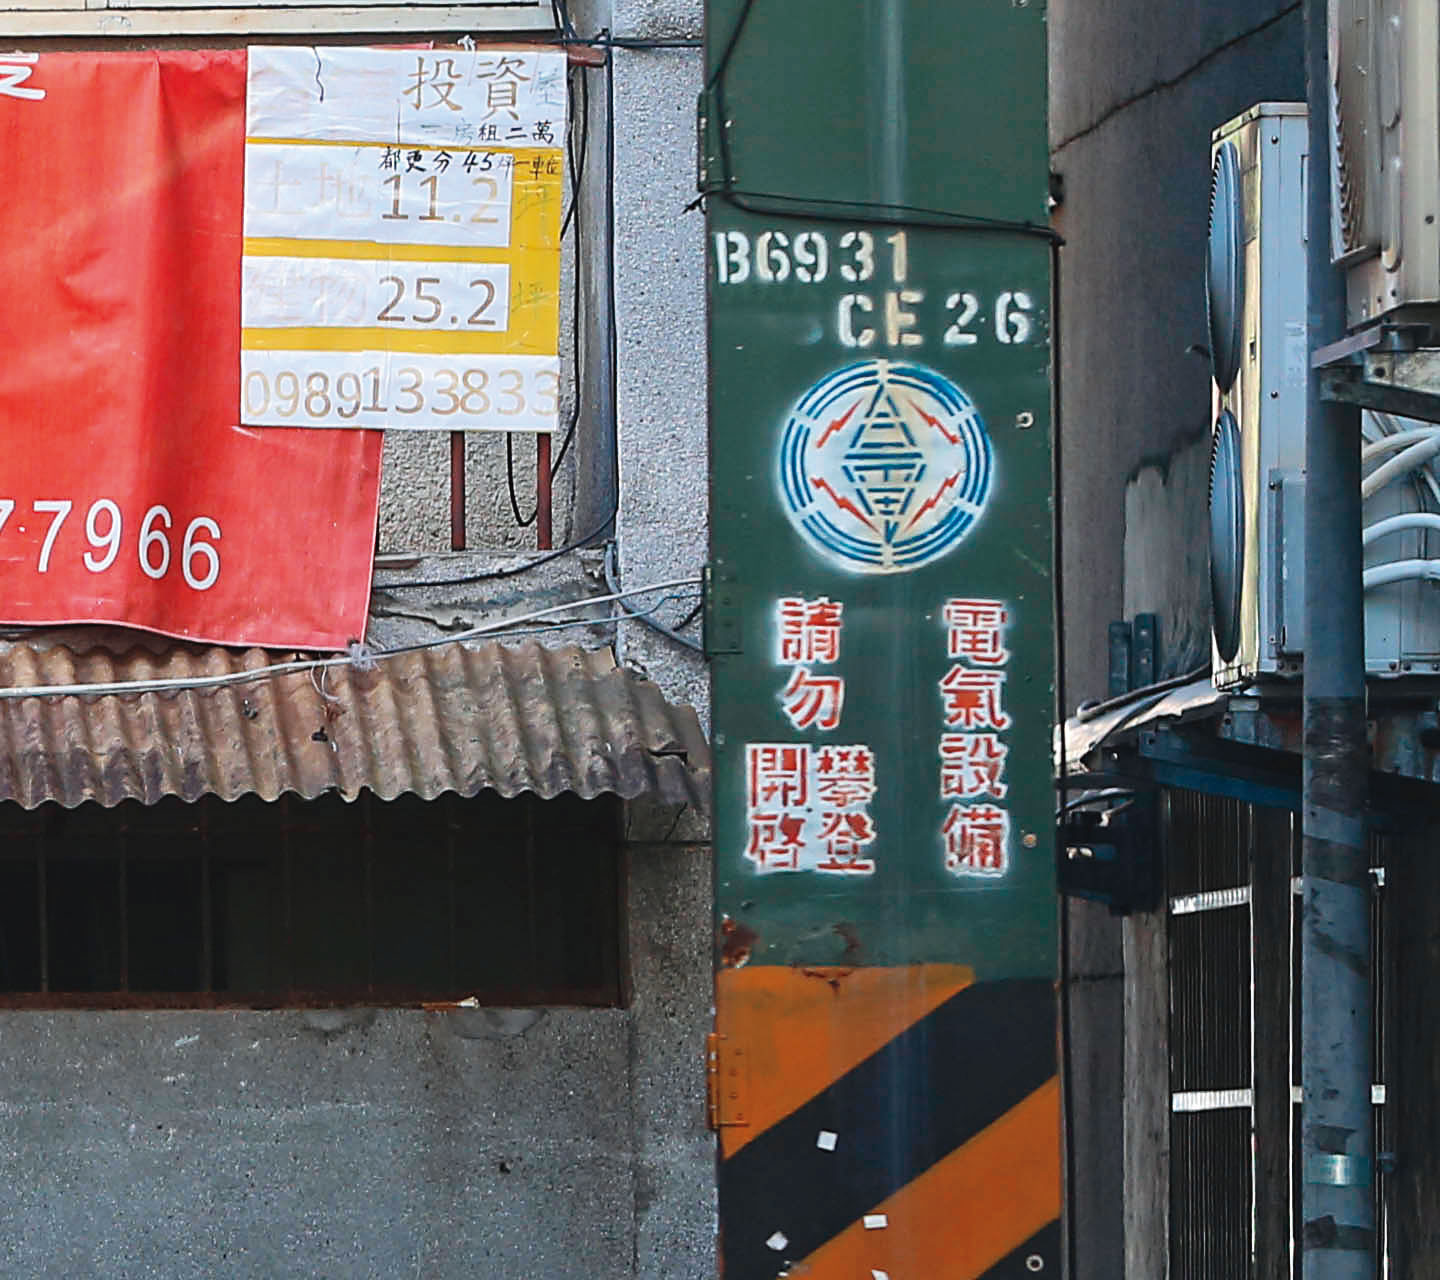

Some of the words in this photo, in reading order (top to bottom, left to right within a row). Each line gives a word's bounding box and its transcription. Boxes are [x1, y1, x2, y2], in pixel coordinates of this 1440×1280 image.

[381, 173, 500, 224] 11.2
[714, 230, 910, 285] B6931
[376, 275, 497, 326] 25.2
[244, 365, 561, 419] 0989133833
[774, 596, 846, 732] 請勿
[938, 597, 1012, 879] 電氣設備
[815, 743, 877, 874] 攀登
